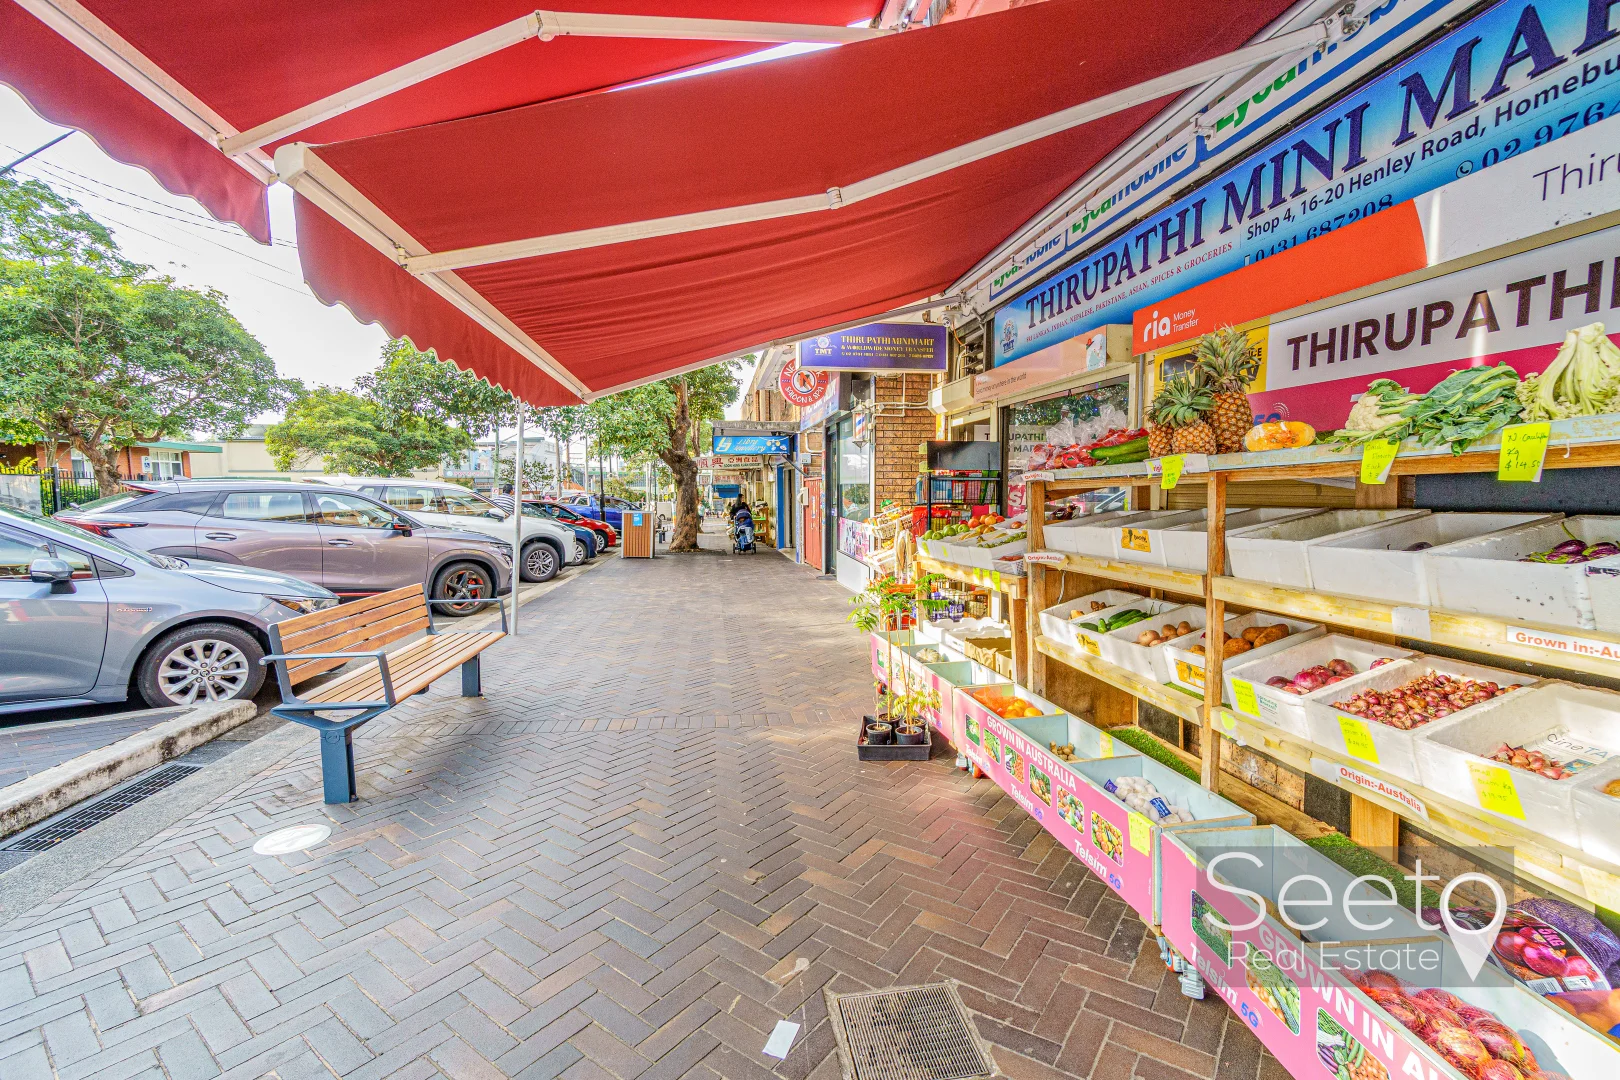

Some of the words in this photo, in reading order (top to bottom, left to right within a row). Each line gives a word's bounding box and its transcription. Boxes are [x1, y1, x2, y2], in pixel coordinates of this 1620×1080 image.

[1246, 215, 1280, 241] Shop
[1282, 207, 1296, 223] 4,
[1300, 183, 1344, 215] 16-20
[1349, 151, 1416, 193] Henley
[1421, 115, 1487, 160] Road,
[1533, 150, 1620, 201] Thir
[1026, 197, 1207, 329] THIRUPATHI
[1219, 101, 1371, 232] MINI
[1150, 269, 1175, 286] SPICES
[1176, 265, 1182, 275] &
[1184, 241, 1233, 270] GROCERIES
[1143, 310, 1171, 343] ria
[1173, 308, 1196, 323] Money
[1173, 317, 1199, 333] Transfer
[840, 335, 891, 344] THIRUPATHI
[1002, 340, 1015, 352] TMT
[1515, 631, 1568, 650] Grown
[987, 715, 1015, 746] GROWN
[1015, 735, 1025, 753] IN
[1025, 744, 1077, 792] AUSTRALIA
[1011, 783, 1034, 812] Telsim
[1074, 838, 1107, 878] Telsim
[1538, 928, 1566, 947] 5KG
[1190, 942, 1239, 1004] Telsim
[1240, 1002, 1259, 1028] 5G
[1258, 925, 1355, 1026] GROWN
[1362, 1010, 1395, 1061] IN
